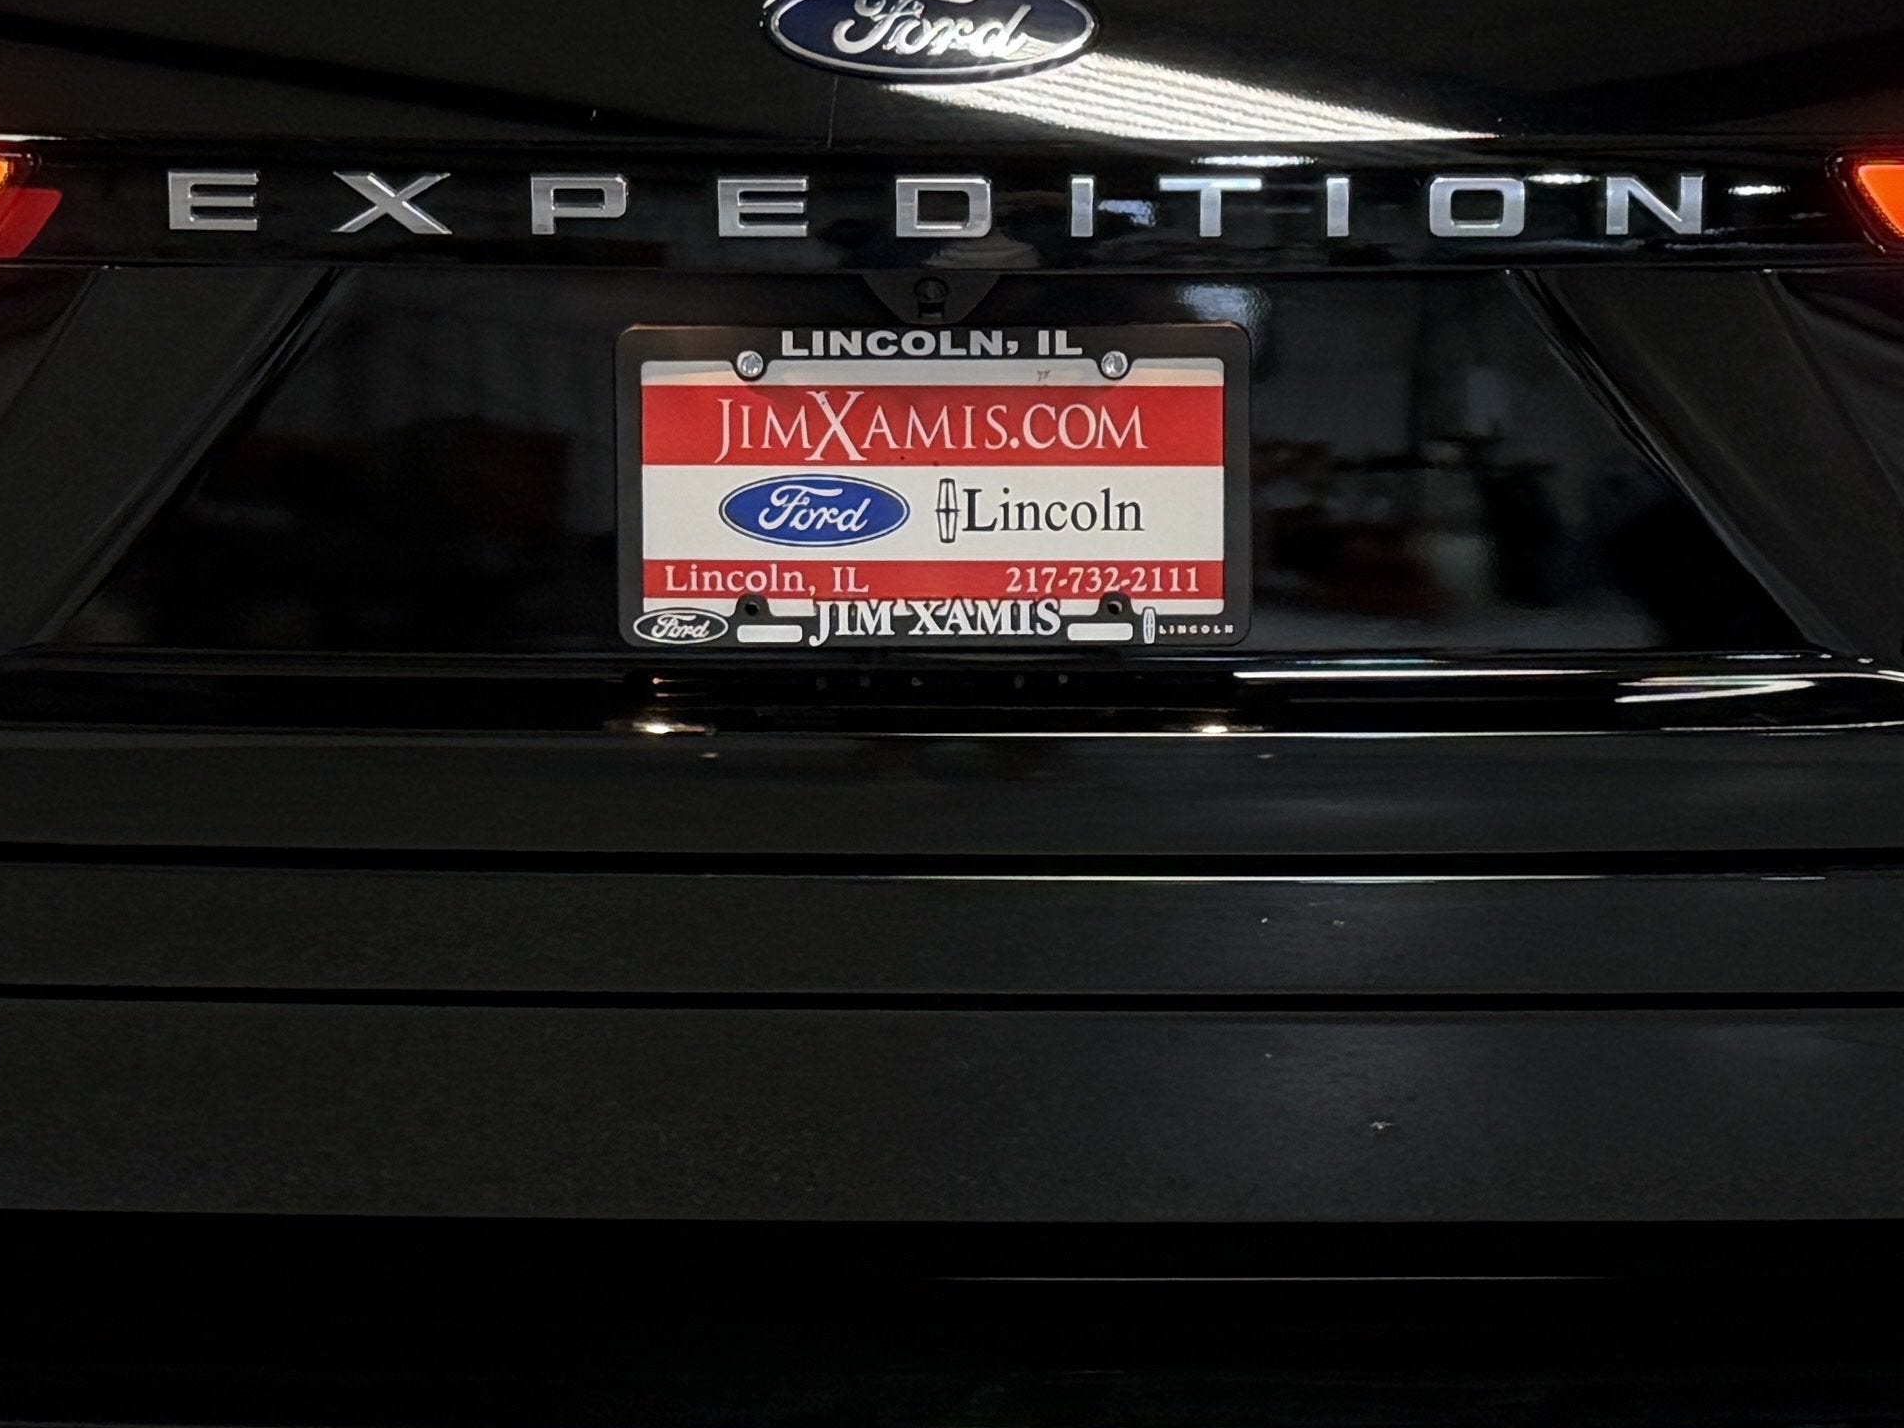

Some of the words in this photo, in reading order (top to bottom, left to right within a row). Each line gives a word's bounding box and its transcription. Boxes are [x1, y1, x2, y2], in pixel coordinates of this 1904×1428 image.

[166, 168, 1704, 238] EXPEDITION
[781, 330, 1020, 357] LINCOLN,
[1037, 330, 1083, 356] IL
[714, 391, 1148, 463] JIMXAMIS.COM
[758, 485, 869, 535] Ford
[962, 487, 1144, 533] Lincoln
[664, 564, 816, 595] Lincoln,
[832, 566, 870, 593] IL
[1005, 566, 1200, 594] 217-732-2111
[651, 614, 711, 640] Ford
[808, 600, 895, 647] JIM
[908, 599, 1062, 636] XAMIS
[1158, 624, 1234, 635] LINCOLN
